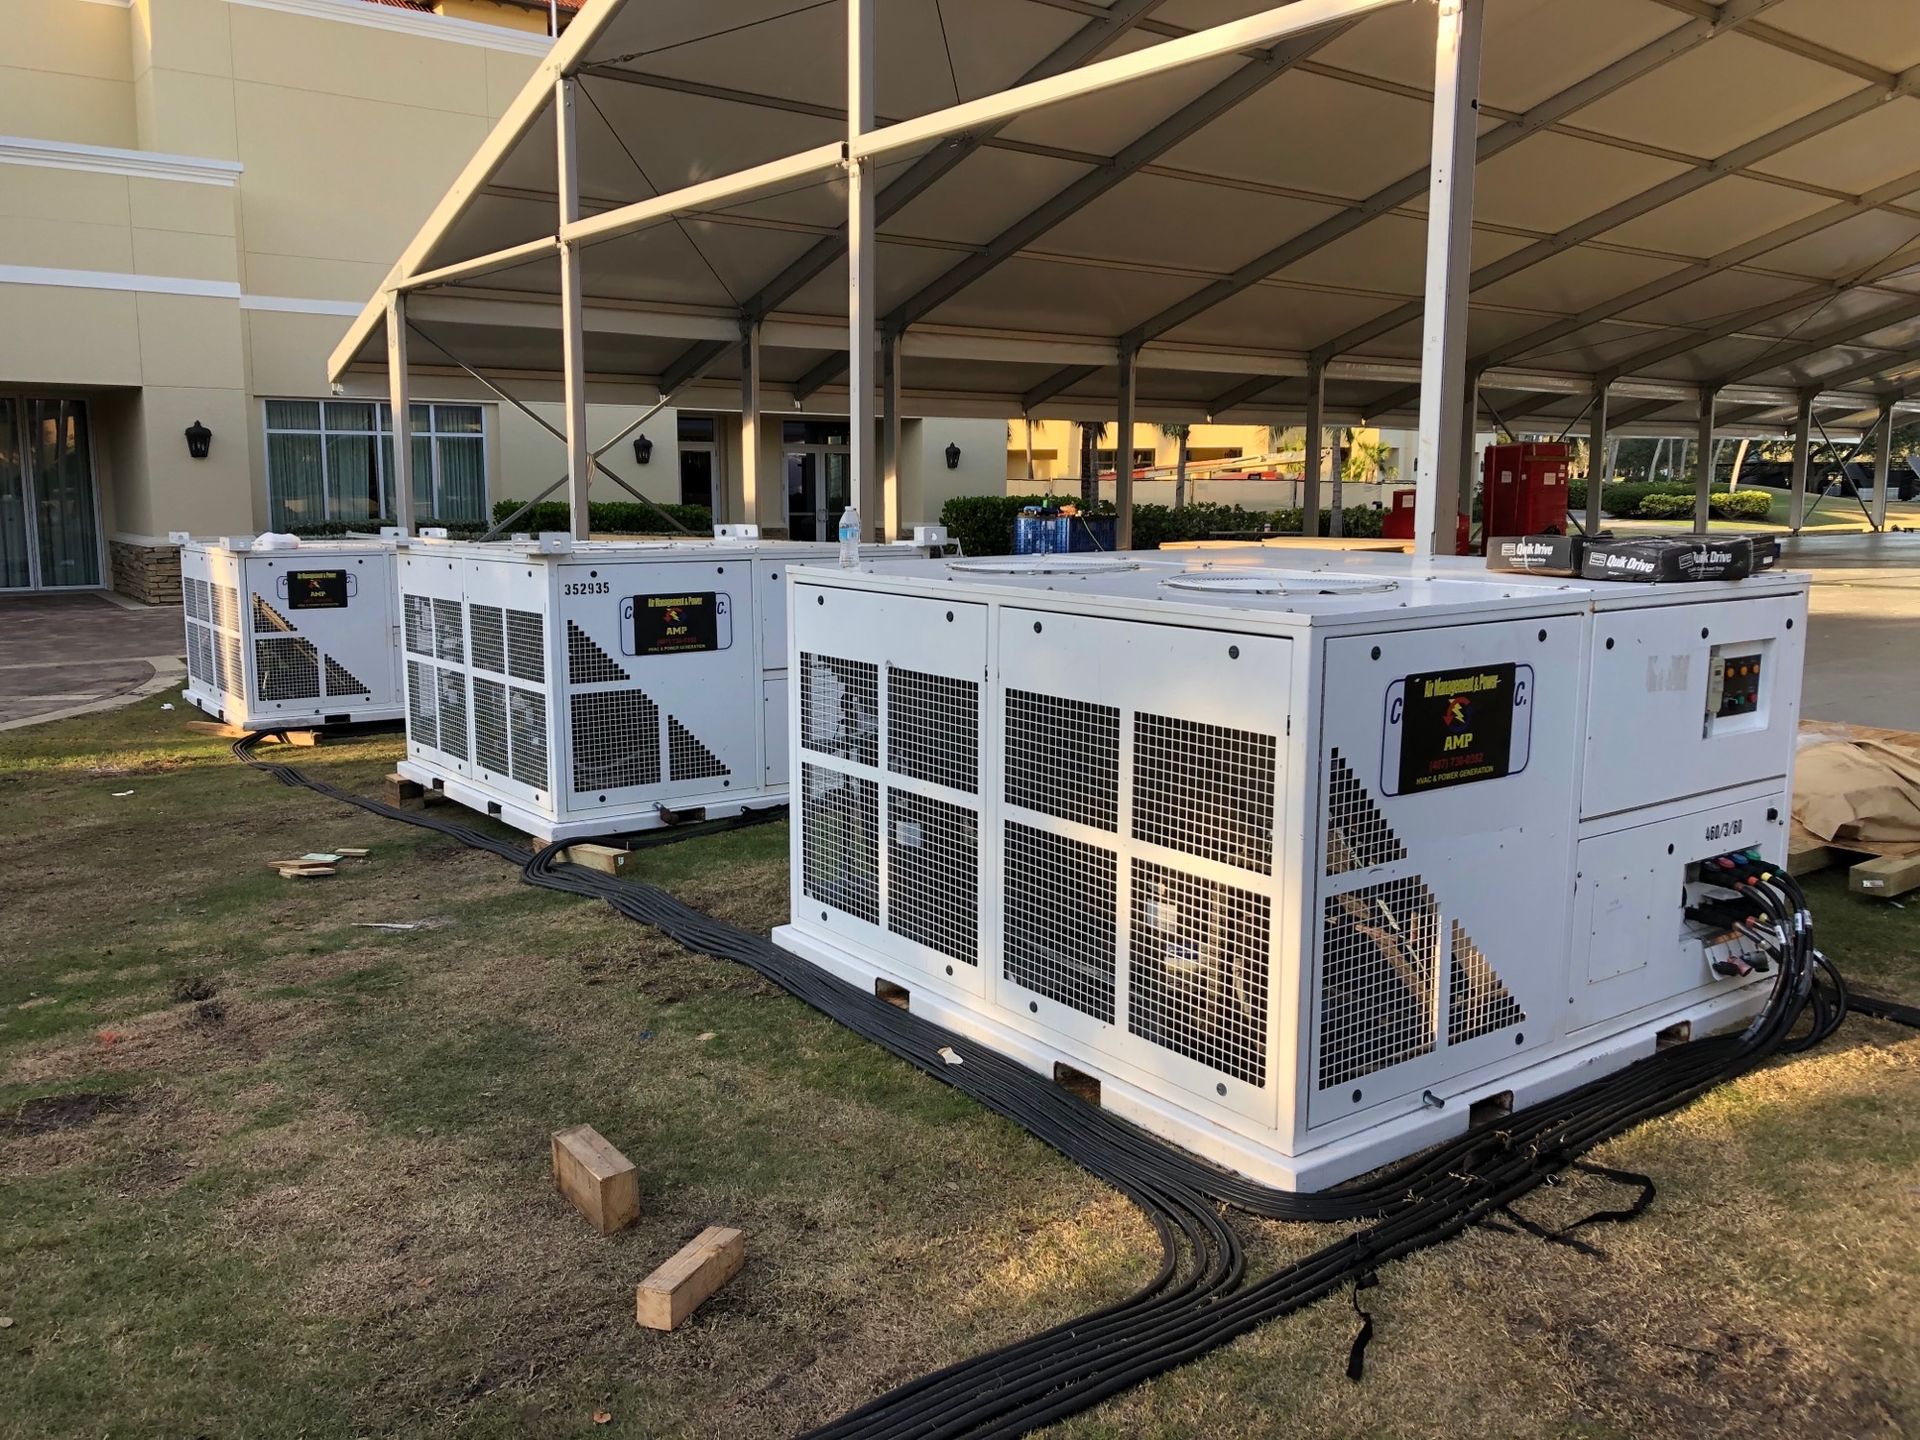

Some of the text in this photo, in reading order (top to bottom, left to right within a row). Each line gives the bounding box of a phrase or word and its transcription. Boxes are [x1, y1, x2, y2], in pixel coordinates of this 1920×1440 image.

[1534, 543, 1553, 555] Drive
[1710, 551, 1732, 563] Drive
[1606, 554, 1627, 568] Quik
[1627, 557, 1655, 573] Drive
[564, 582, 610, 596] 352935
[666, 626, 688, 636] AMP
[1433, 675, 1474, 697] Management
[1444, 733, 1473, 751] AMP
[1416, 774, 1432, 785] HVAC
[1438, 770, 1459, 781] POWER
[1459, 765, 1495, 778] GENERATION
[1705, 819, 1743, 841] 460/3/60
